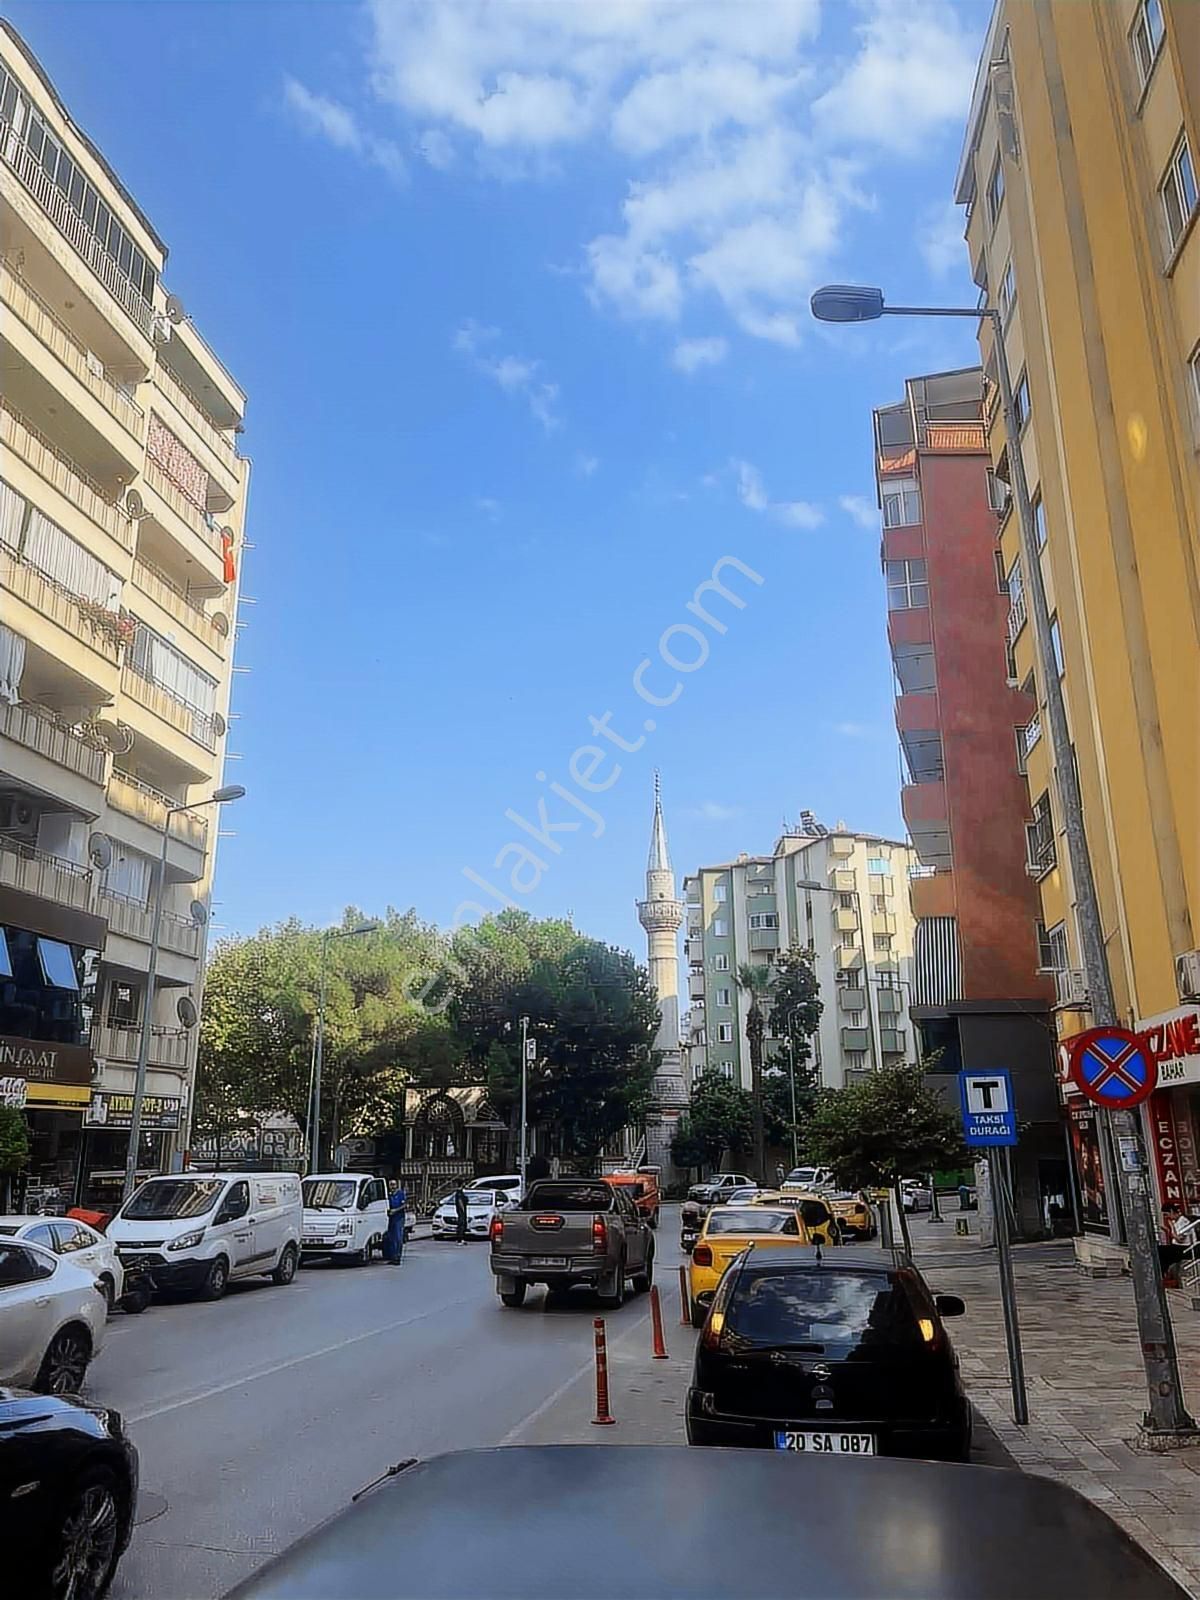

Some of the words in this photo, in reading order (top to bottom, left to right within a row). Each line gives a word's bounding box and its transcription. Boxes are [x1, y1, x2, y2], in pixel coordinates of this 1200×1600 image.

[972, 1081, 999, 1109] T
[973, 1113, 1004, 1124] TAKSİ
[1158, 1121, 1181, 1199] ECZAN
[786, 1433, 806, 1451] 20
[813, 1434, 833, 1451] SA
[840, 1435, 871, 1453] 087
